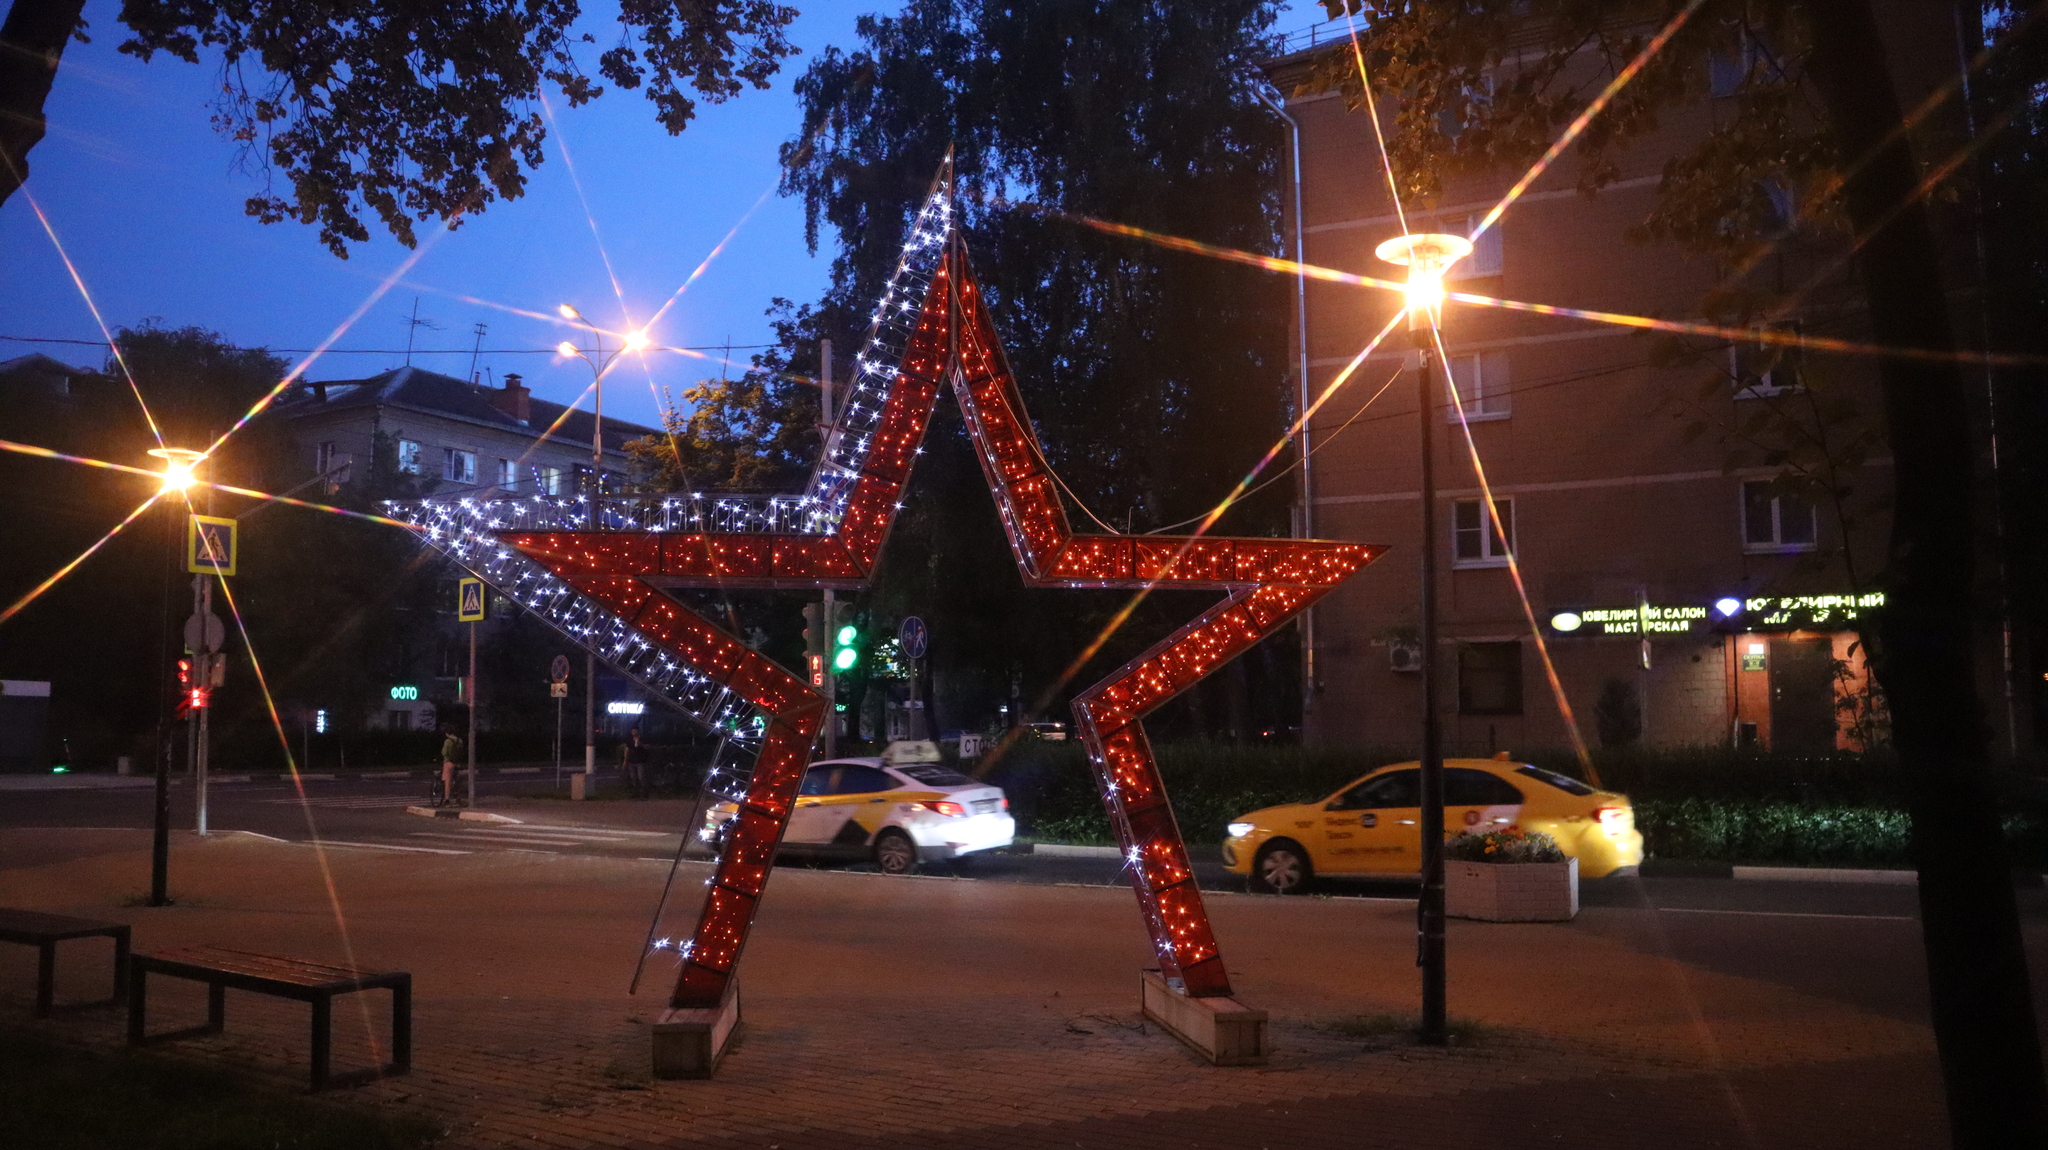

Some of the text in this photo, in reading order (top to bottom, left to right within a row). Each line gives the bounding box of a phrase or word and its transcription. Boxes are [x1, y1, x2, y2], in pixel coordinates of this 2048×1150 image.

[1746, 592, 1884, 611] ЮЕЛИРНЫЙ
[1663, 607, 1706, 619] САЛОН
[1604, 620, 1689, 633] МАСТРСКАЯ
[390, 686, 418, 700] ФОТО
